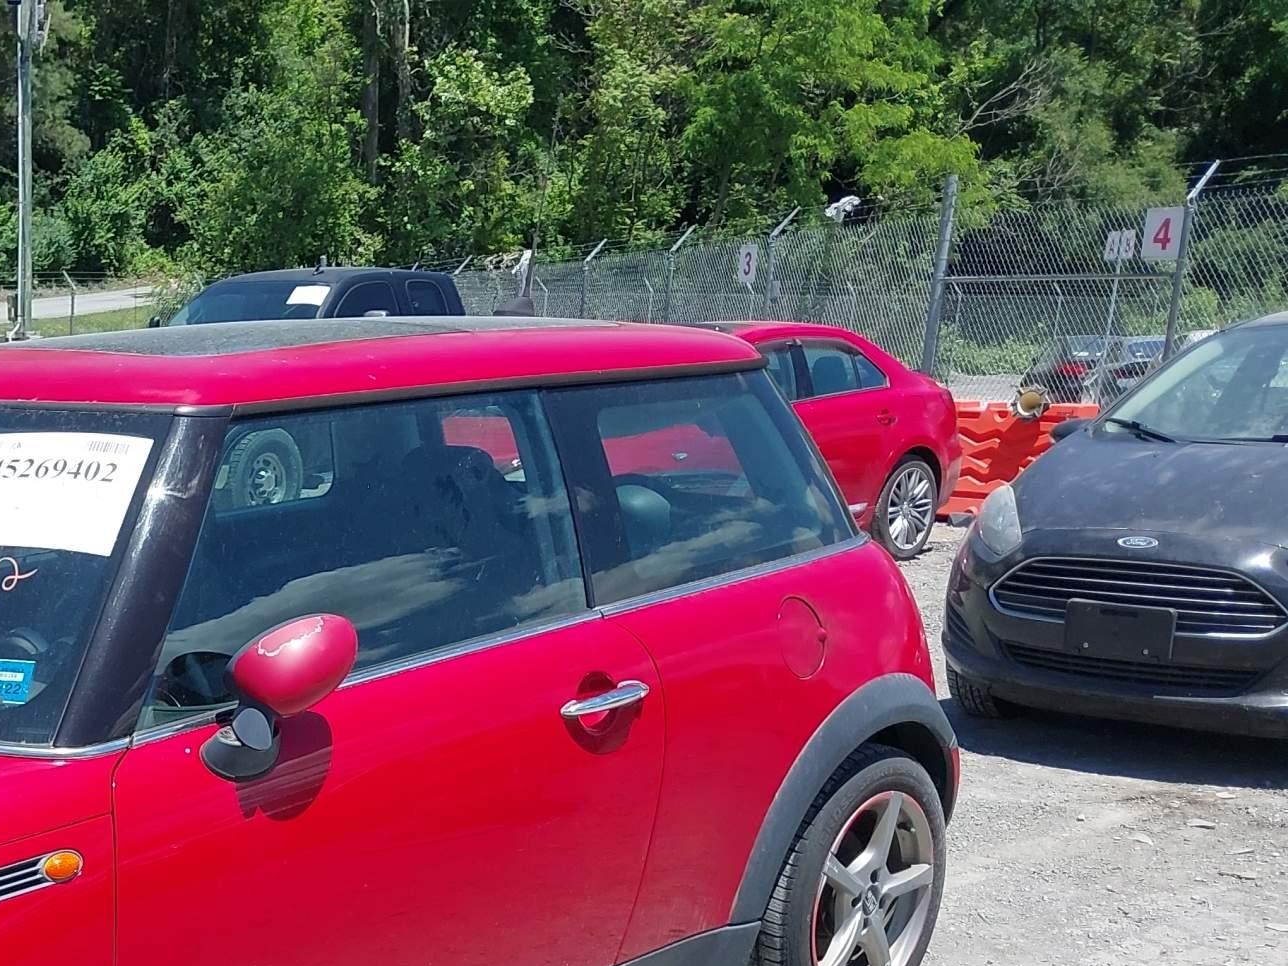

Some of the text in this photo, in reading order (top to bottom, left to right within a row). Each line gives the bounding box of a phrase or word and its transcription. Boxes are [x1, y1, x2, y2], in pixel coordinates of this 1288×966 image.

[1152, 217, 1172, 251] 4
[743, 251, 752, 276] 3
[4, 682, 23, 696] 22
